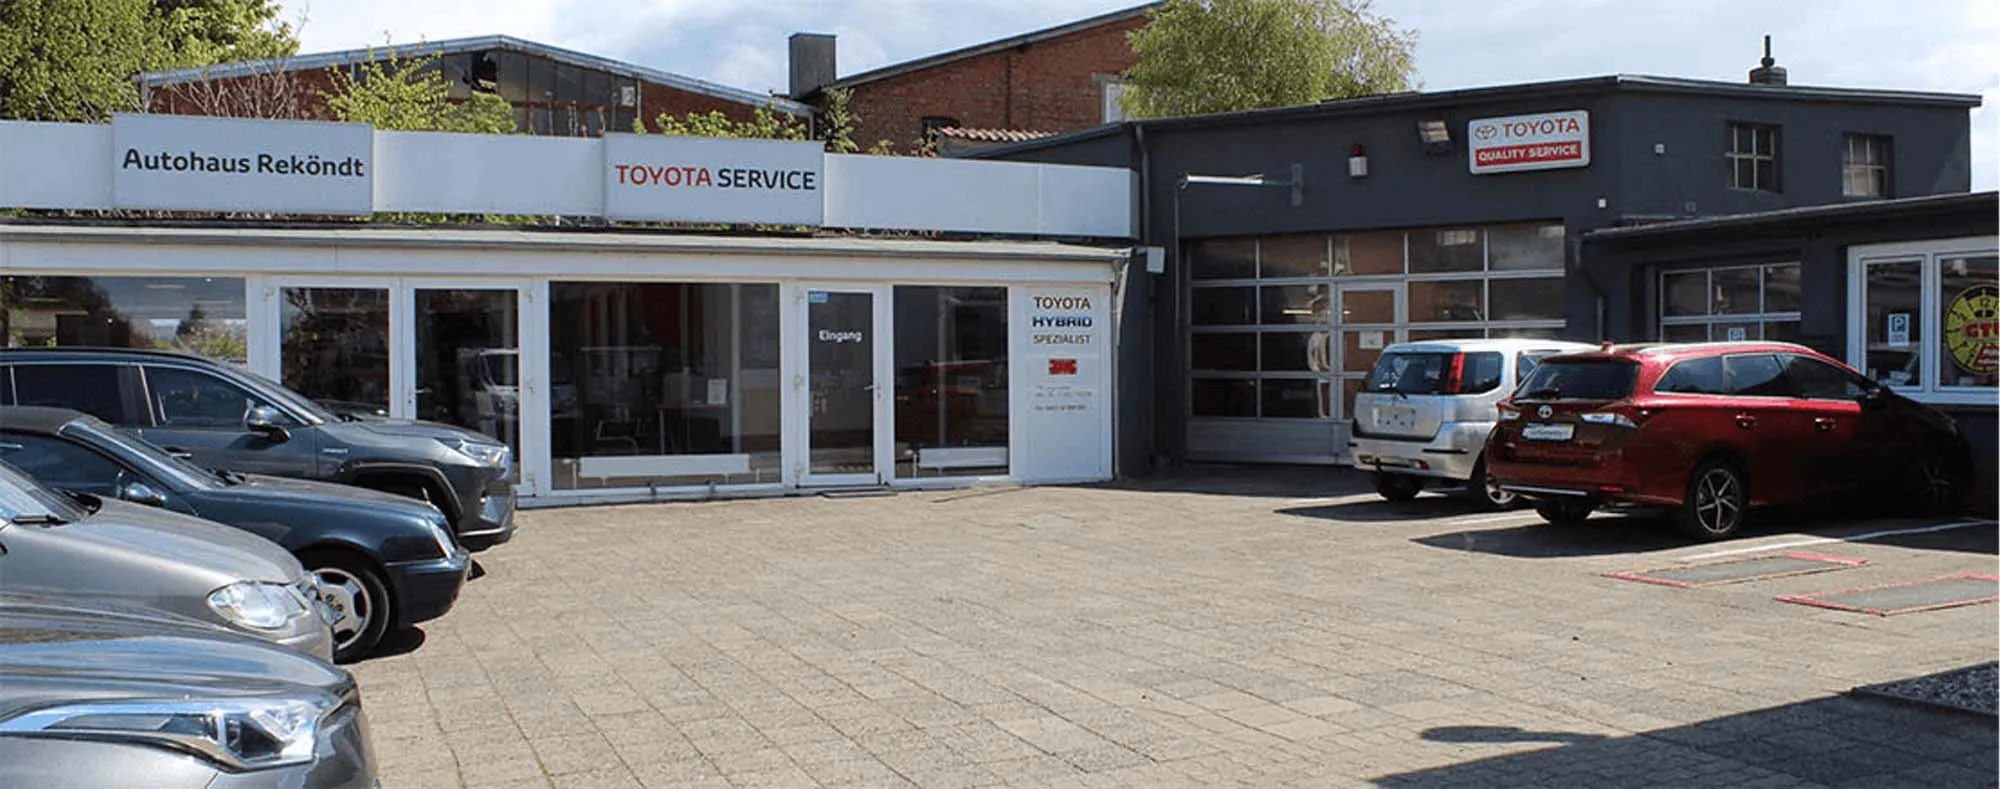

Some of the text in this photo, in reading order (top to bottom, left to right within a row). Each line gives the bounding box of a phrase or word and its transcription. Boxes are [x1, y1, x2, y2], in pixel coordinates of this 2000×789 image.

[1503, 118, 1580, 138] TOYOTA
[1479, 143, 1578, 161] QUALITY SERVICE
[122, 148, 365, 177] Autohaus Reköndt
[615, 164, 816, 190] TOYOTA SERVICE
[1033, 296, 1091, 310] TOYOTA
[1032, 316, 1093, 328] HYBRID
[818, 329, 863, 343] Eingang
[1033, 334, 1092, 345] SPEZIALIST
